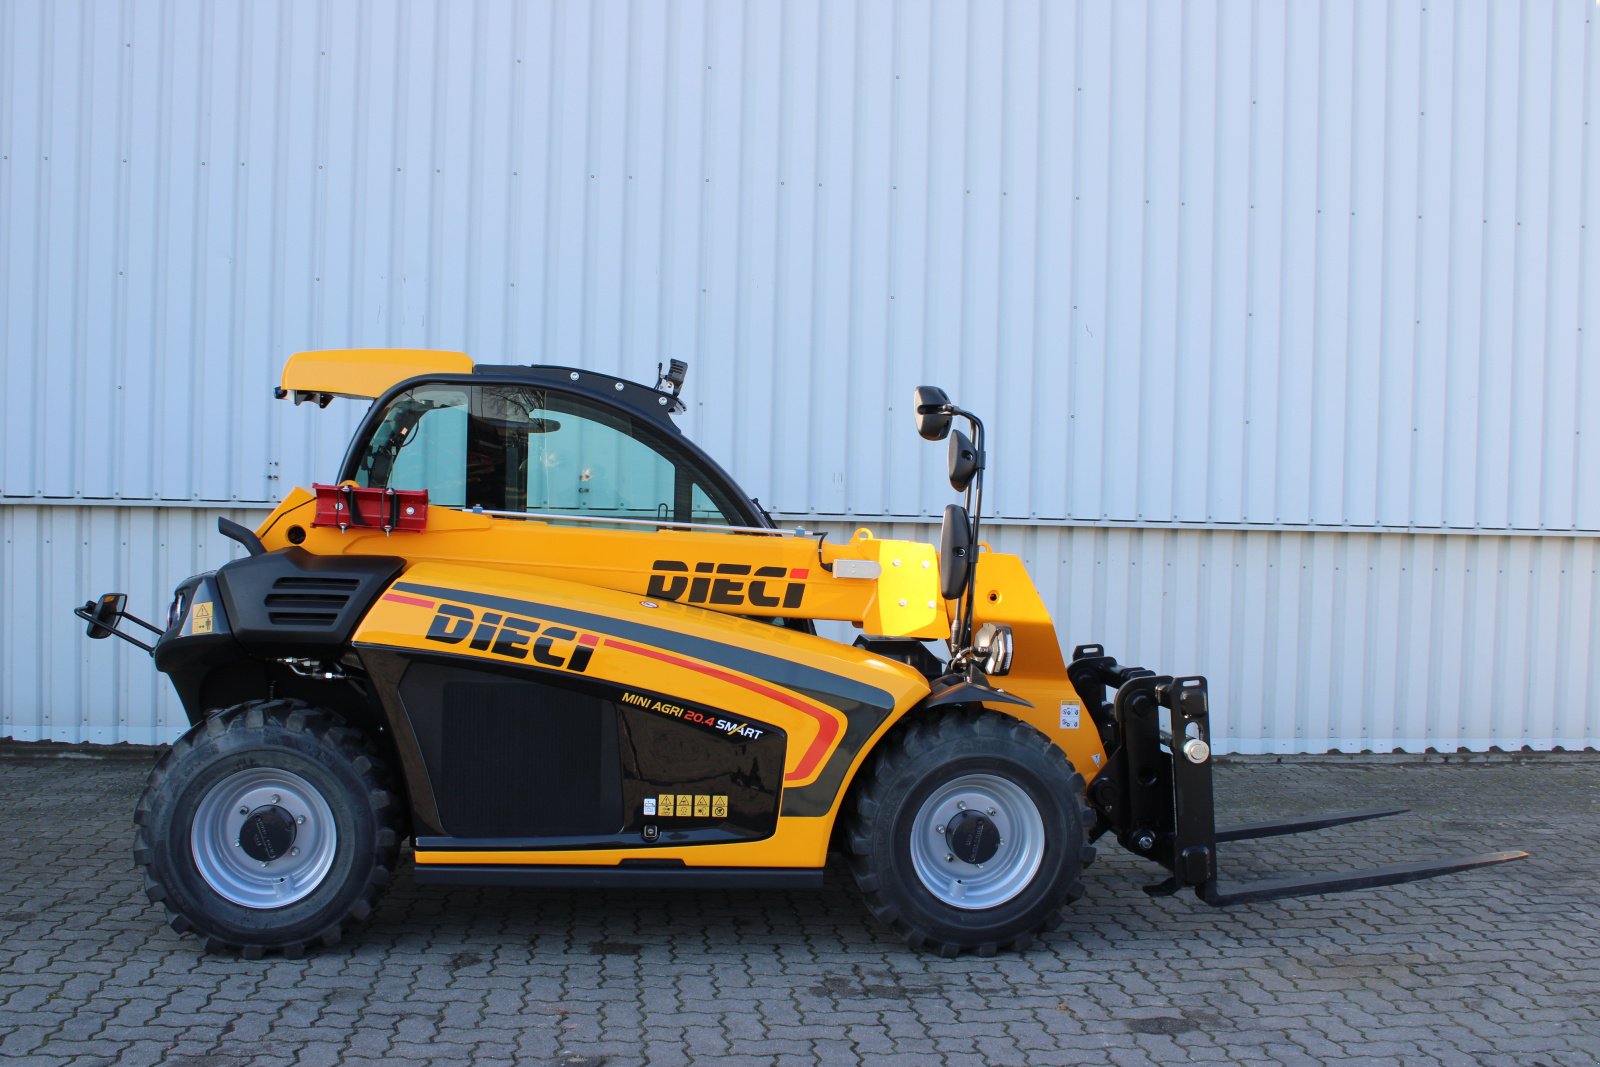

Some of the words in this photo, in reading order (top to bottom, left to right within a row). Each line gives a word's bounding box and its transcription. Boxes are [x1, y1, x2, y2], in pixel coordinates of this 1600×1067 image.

[621, 692, 651, 709] MINI
[651, 701, 684, 718] AGRI
[683, 710, 716, 727] 20.4
[715, 719, 764, 740] SMART
